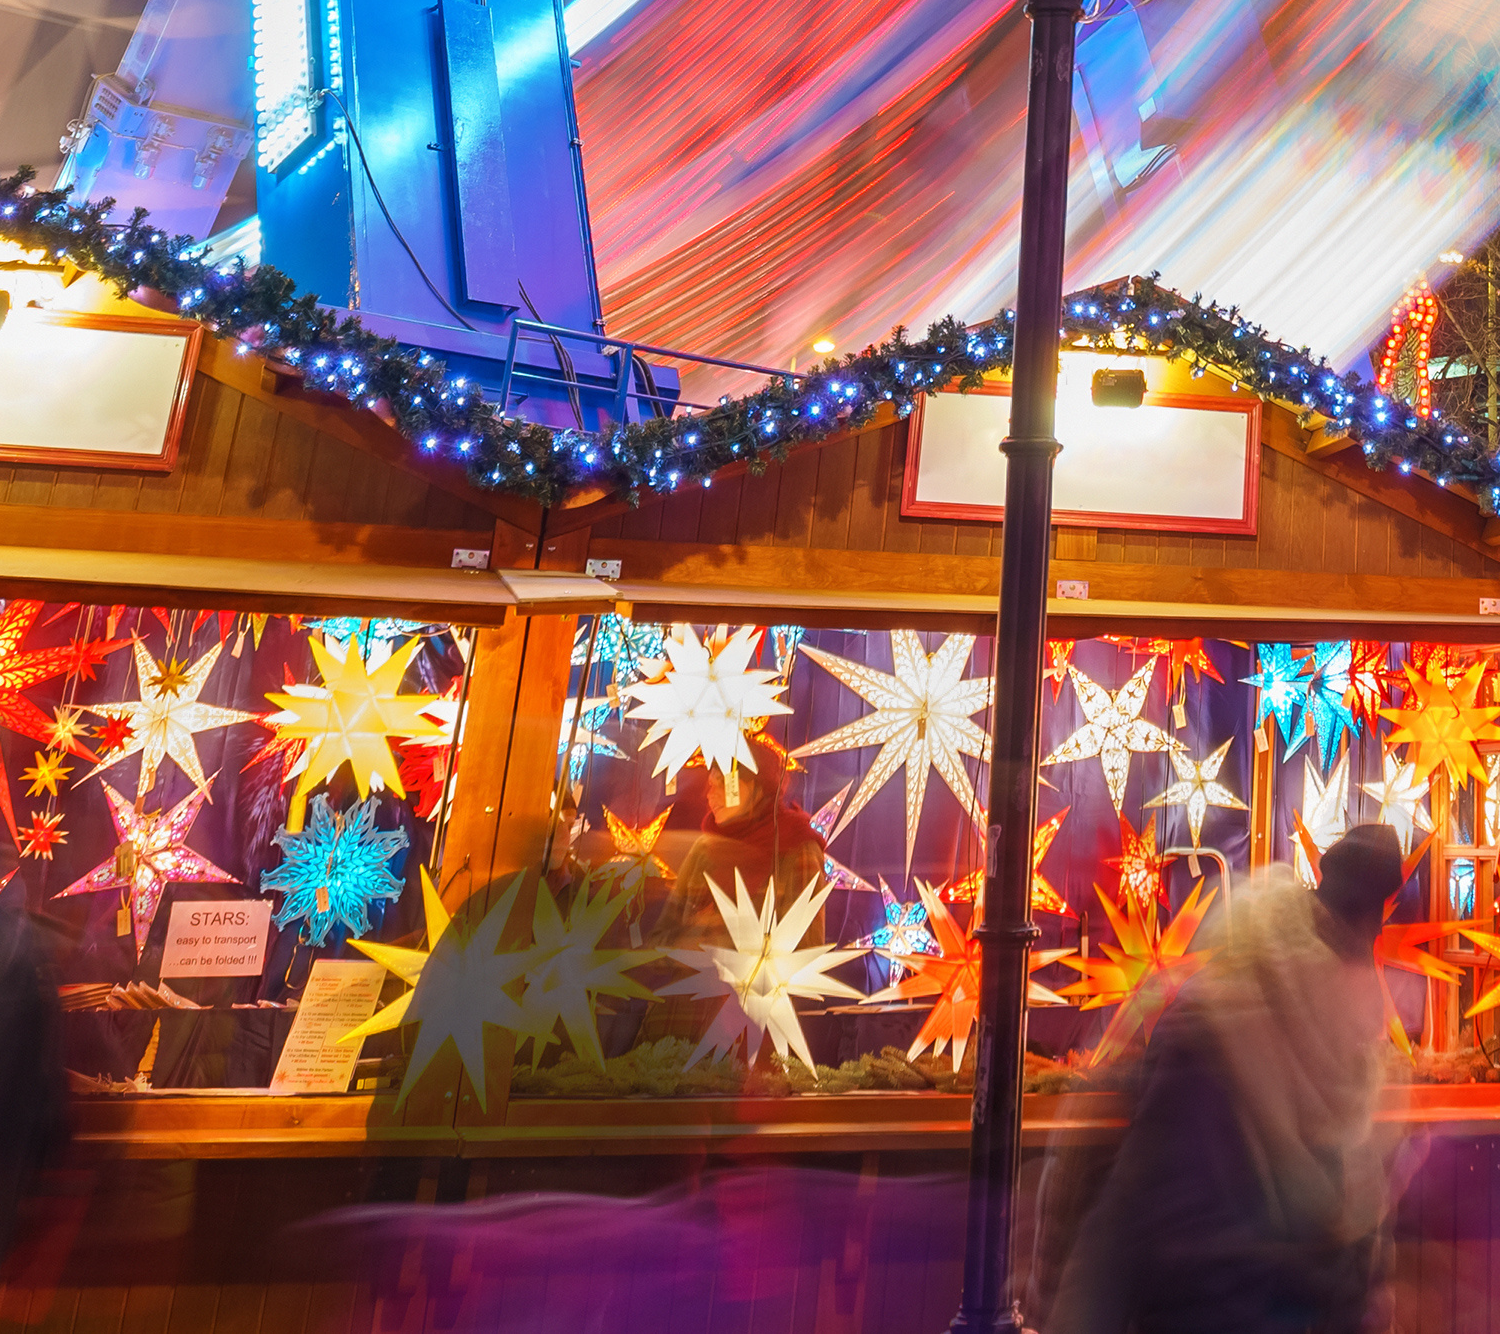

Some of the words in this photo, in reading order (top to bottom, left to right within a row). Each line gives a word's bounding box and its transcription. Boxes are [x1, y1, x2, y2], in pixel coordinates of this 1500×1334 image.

[190, 912, 250, 926] STARS:
[176, 935, 199, 947] easy
[202, 935, 211, 944] to
[214, 935, 257, 946] transport
[200, 955, 213, 965] be
[215, 955, 245, 965] folded
